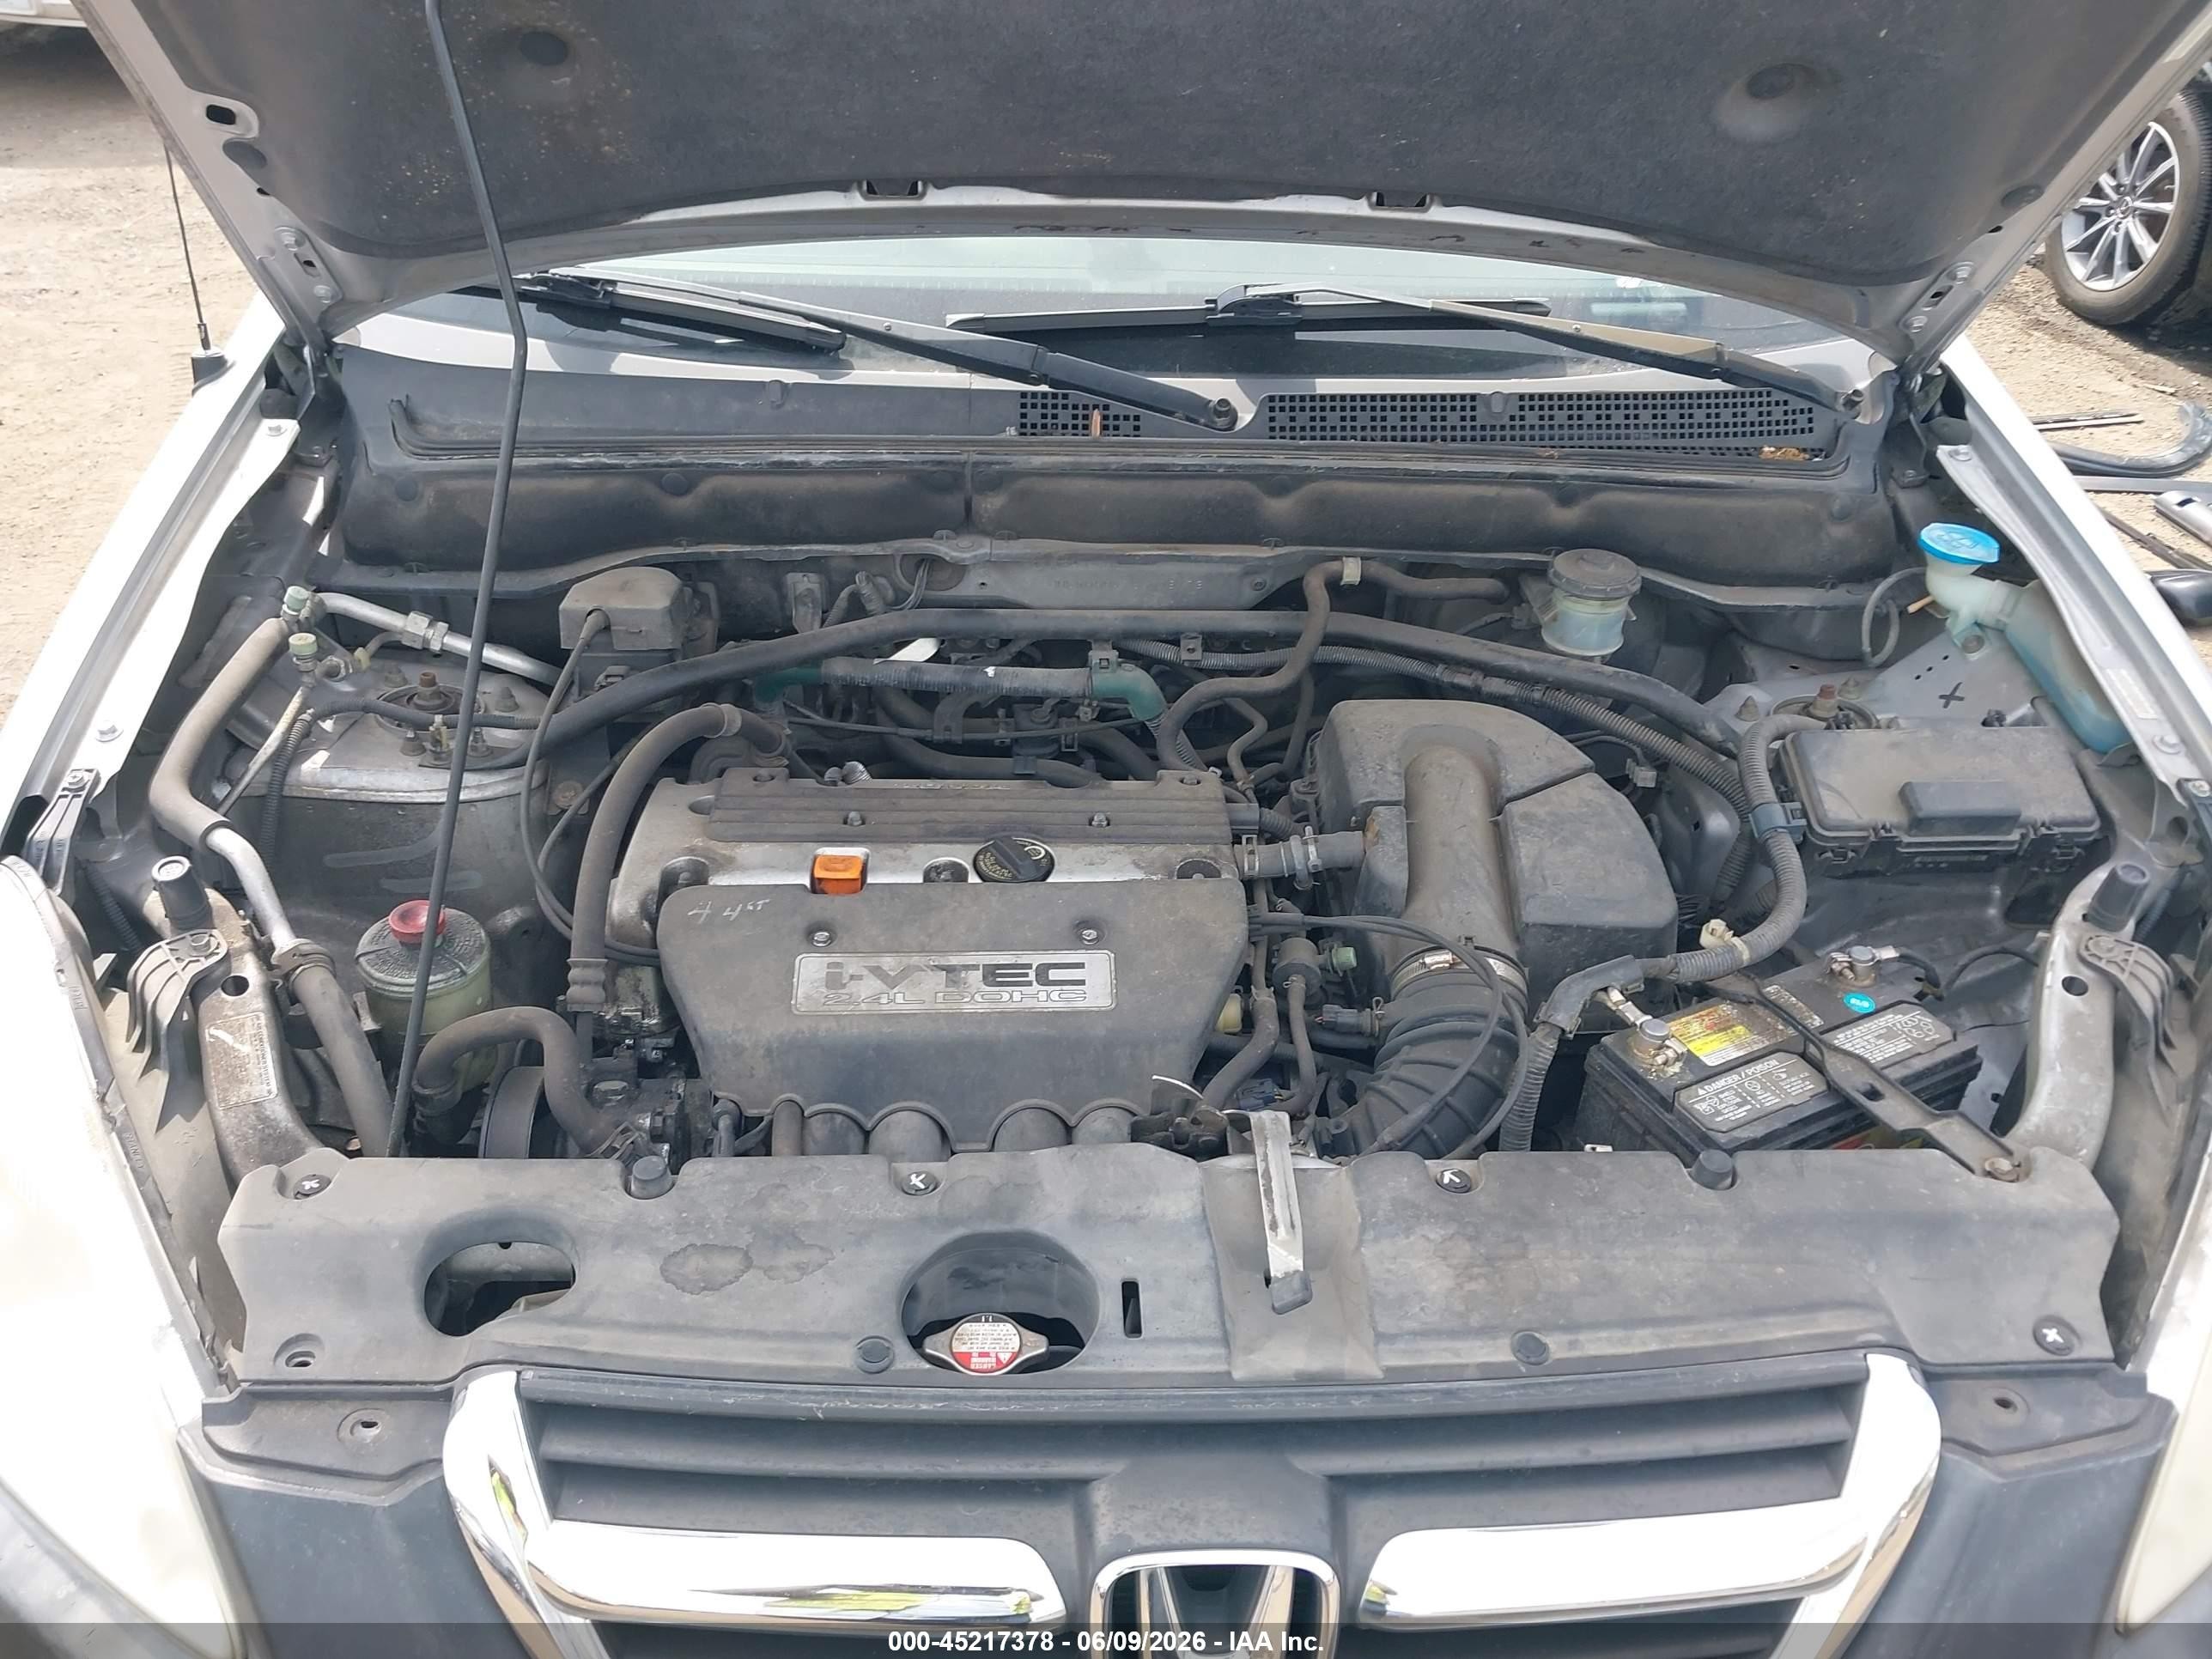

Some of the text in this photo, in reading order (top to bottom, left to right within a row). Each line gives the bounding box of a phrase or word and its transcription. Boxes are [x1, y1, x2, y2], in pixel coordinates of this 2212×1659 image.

[825, 961, 1086, 990] i-VTEC
[823, 989, 1088, 1006] 2.4L DOHC
[1705, 1073, 1741, 1093] DANGER
[1746, 1059, 1780, 1076] POISON
